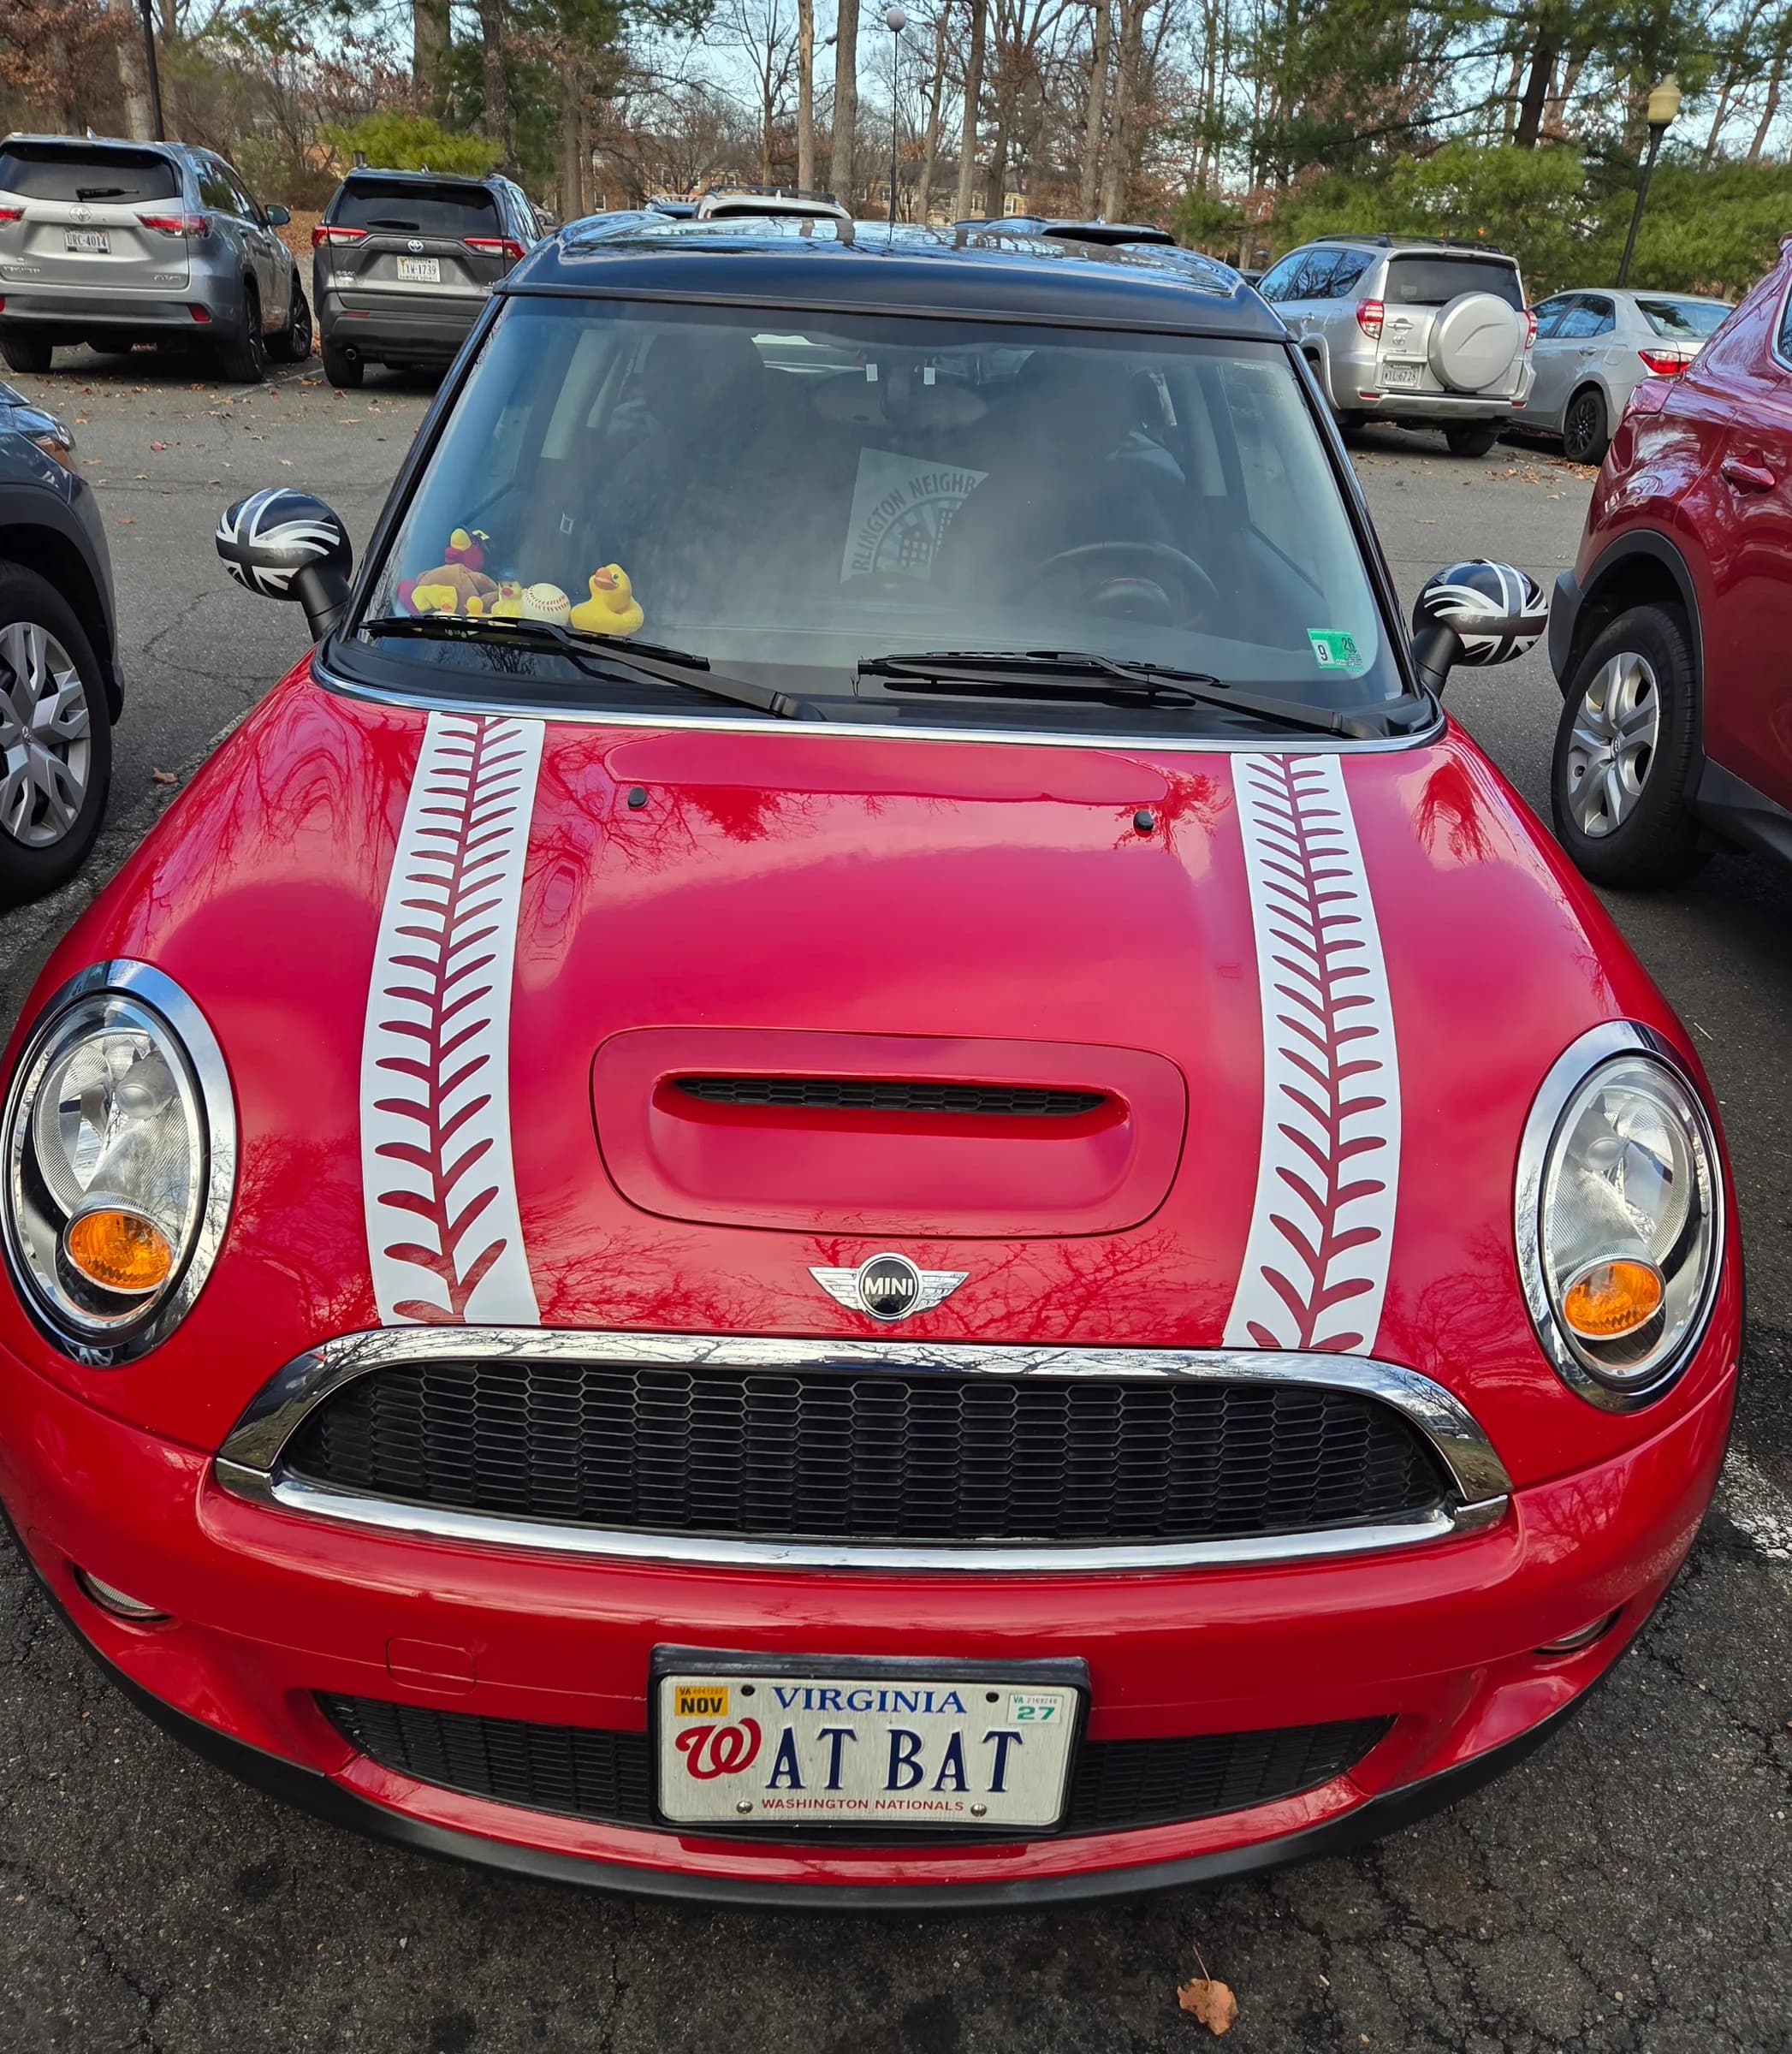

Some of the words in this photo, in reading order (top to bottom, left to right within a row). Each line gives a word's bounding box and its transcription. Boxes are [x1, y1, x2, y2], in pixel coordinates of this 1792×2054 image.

[1318, 644, 1328, 662] 9
[864, 1277, 913, 1296] MINI
[679, 1687, 691, 1695] VA
[1013, 1695, 1024, 1704] VA
[680, 1697, 722, 1713] NOV
[771, 1686, 967, 1714] VIRGINIA
[1018, 1706, 1055, 1720] 27
[675, 1717, 762, 1780] W
[764, 1725, 858, 1790] AT
[882, 1728, 1024, 1793] BAT
[762, 1798, 869, 1811] WASHINGTON
[875, 1800, 964, 1812] NATIONALS
